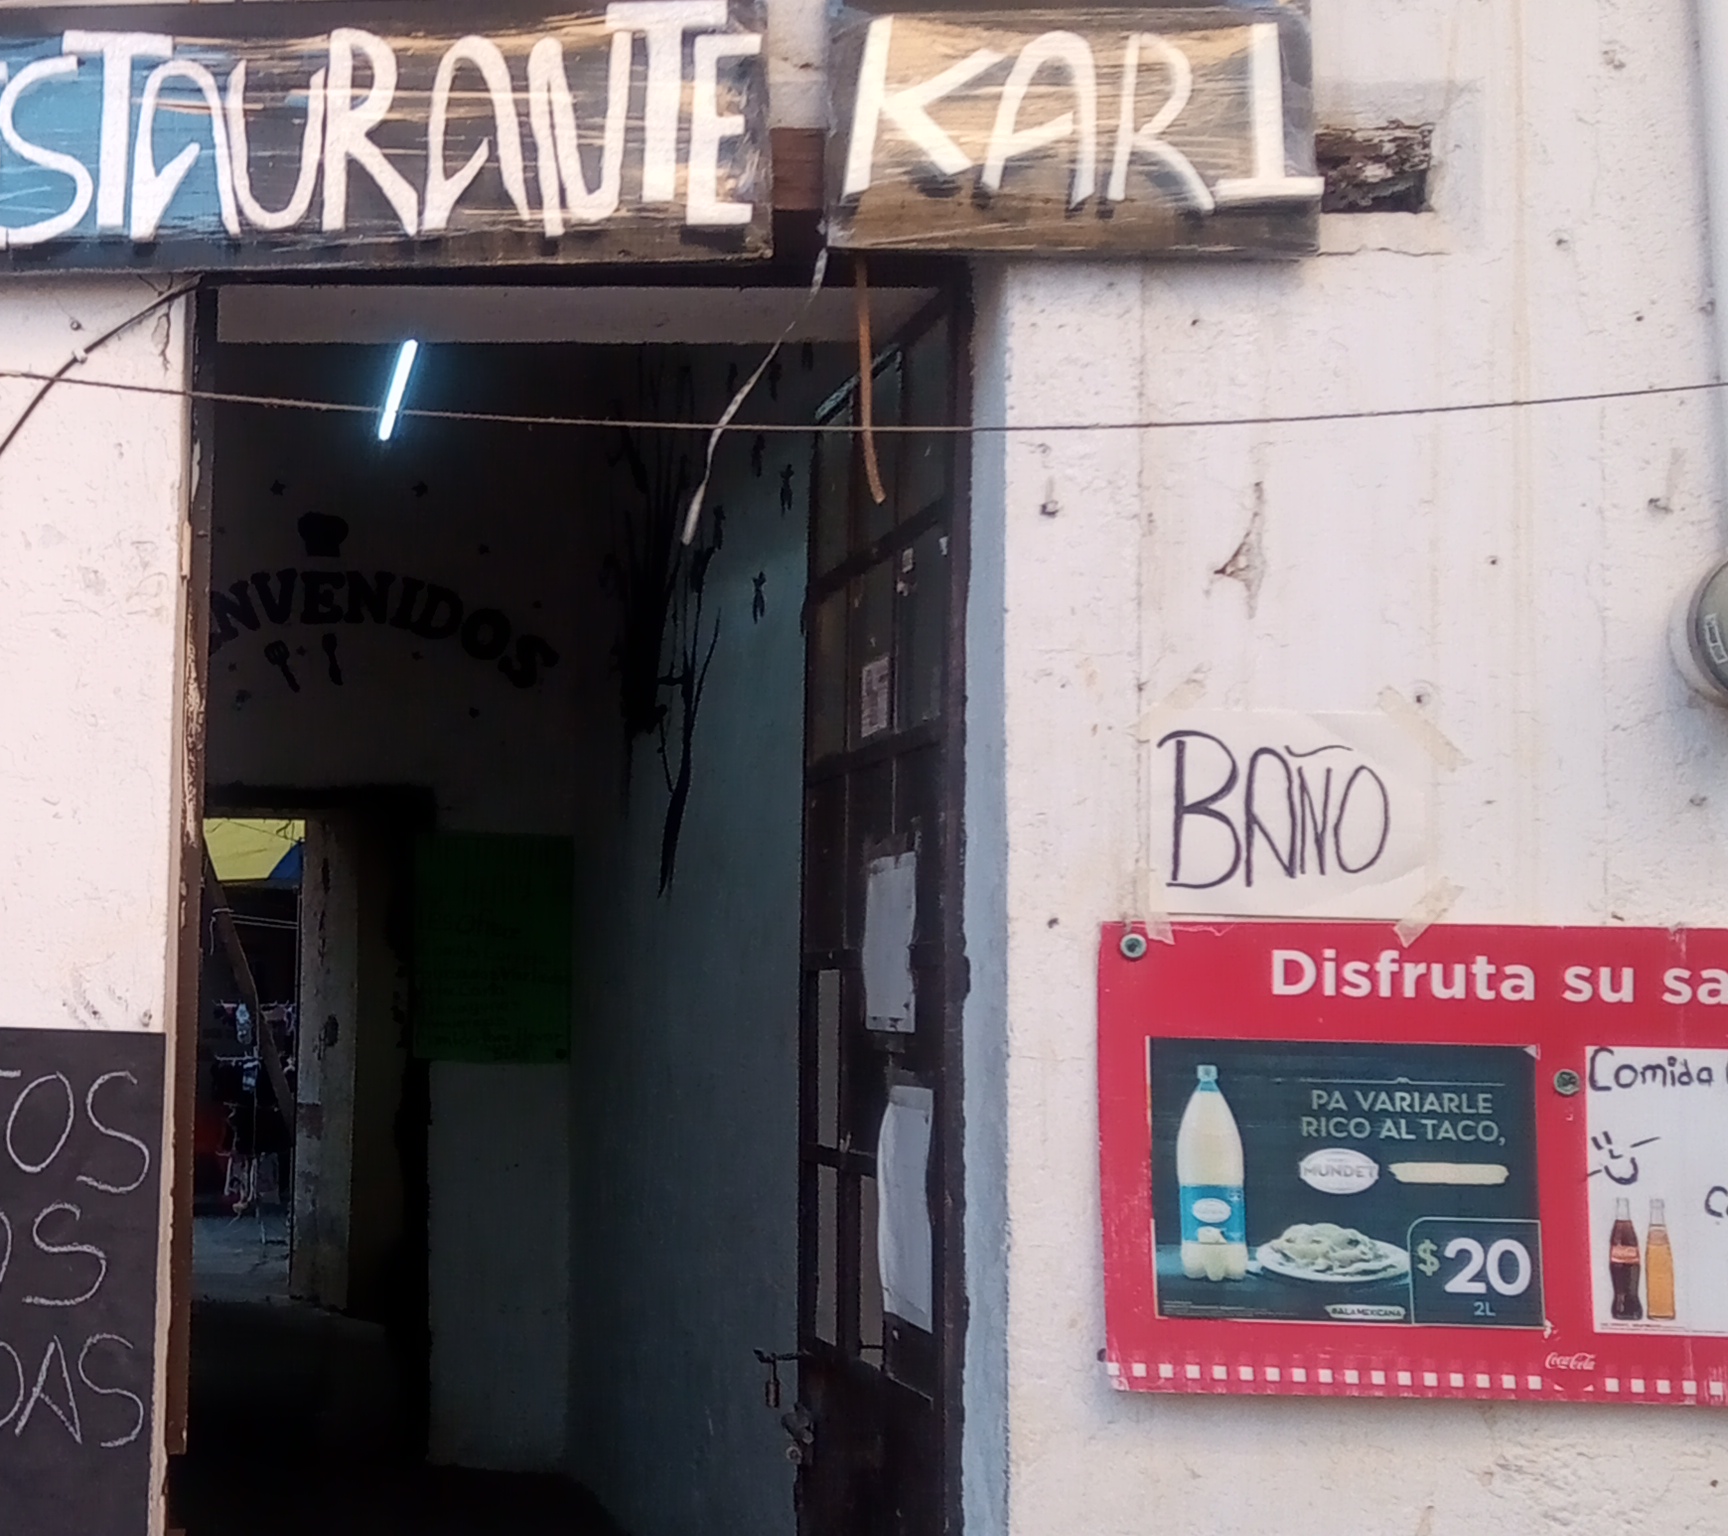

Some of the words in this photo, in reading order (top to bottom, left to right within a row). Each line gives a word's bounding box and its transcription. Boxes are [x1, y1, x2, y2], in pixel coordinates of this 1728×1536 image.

[210, 567, 561, 690] NVENIDOS
[1156, 729, 1391, 890] BAÑO
[1270, 947, 1537, 1003] Disfruta
[1561, 963, 1636, 1004] su
[1661, 966, 1728, 1006] sa
[1588, 1047, 1715, 1092] Comida
[1310, 1088, 1349, 1112] PA
[1353, 1089, 1494, 1114] VARIARLE
[1300, 1115, 1372, 1139] RICO
[1378, 1117, 1417, 1140] AL
[1417, 1117, 1507, 1146] TACO,
[1472, 1301, 1497, 1318] 2L
